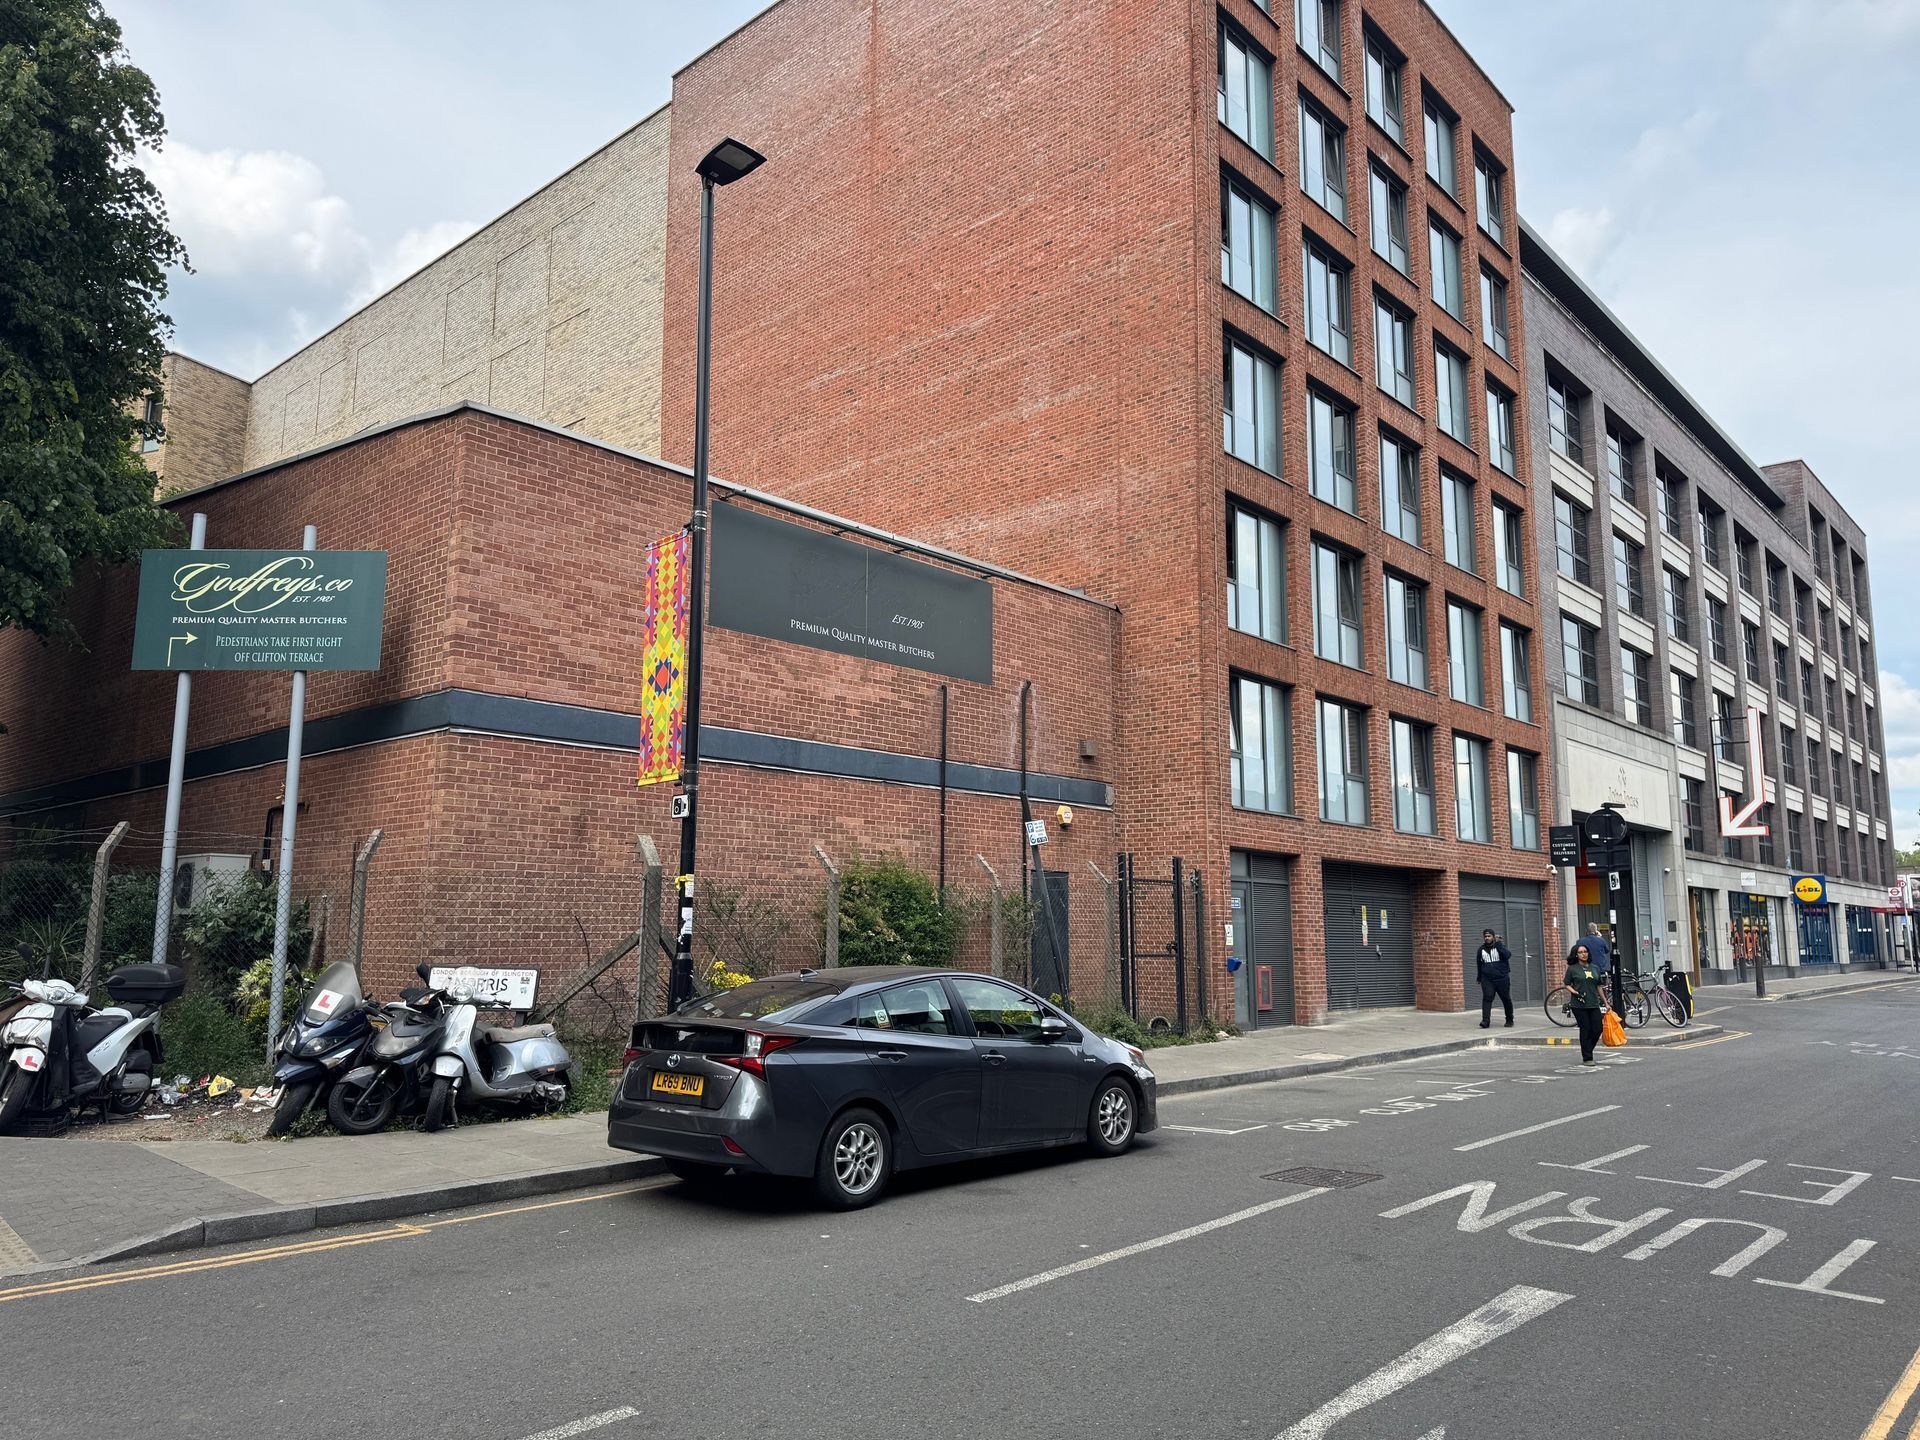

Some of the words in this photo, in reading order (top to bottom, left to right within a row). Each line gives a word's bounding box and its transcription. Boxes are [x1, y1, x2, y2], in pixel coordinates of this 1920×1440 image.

[172, 616, 215, 625] PREMIUM
[218, 616, 258, 626] QUALITY
[260, 616, 296, 625] MASTER
[300, 616, 348, 625] BUTCHERS
[215, 635, 269, 647] PEDESTRIANS
[271, 636, 290, 647] TAKE
[291, 636, 314, 647] FIRST
[316, 637, 343, 648] RIGHT
[790, 618, 830, 637] PREMIUM
[831, 627, 866, 645] QUALITY
[867, 636, 898, 652] MASTER
[898, 643, 936, 660] BUTCHERS
[234, 652, 250, 663] OFF
[251, 652, 287, 663] CLIFTON
[289, 652, 324, 663] TERRACE
[491, 969, 499, 977] OF
[318, 994, 330, 1008] L
[24, 1055, 38, 1068] L
[656, 1074, 679, 1090] LR69
[680, 1076, 701, 1092] BNU
[1377, 1179, 1886, 1304] TURN
